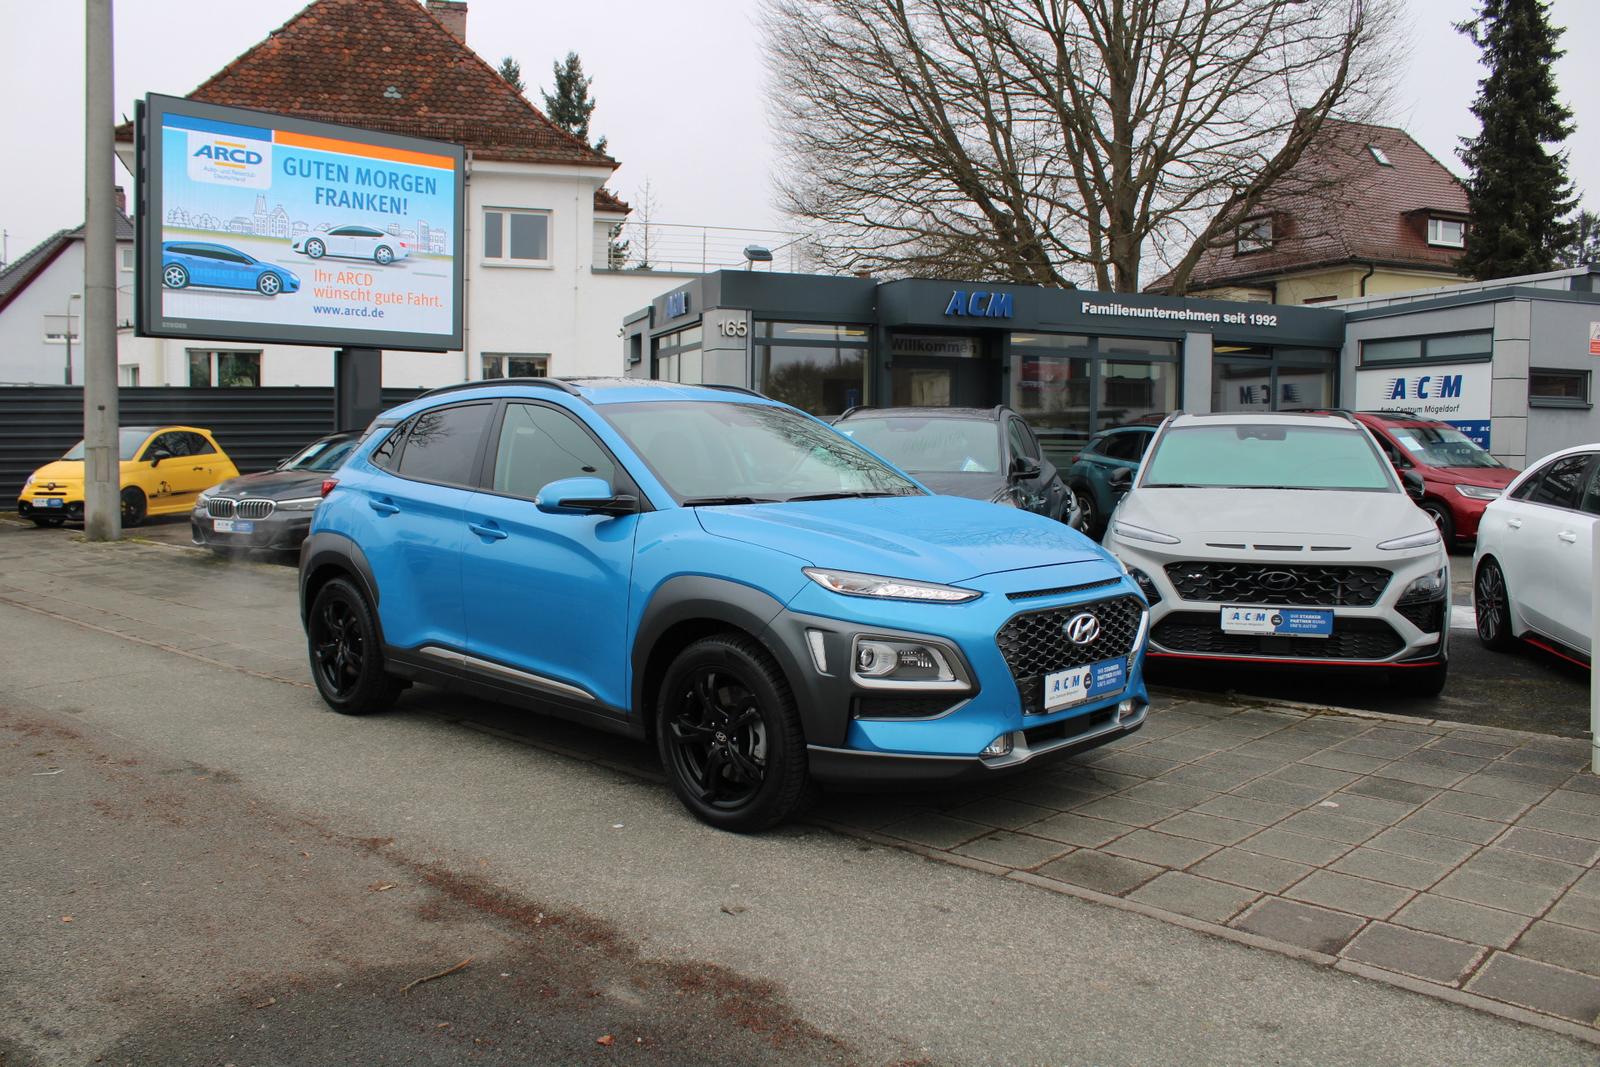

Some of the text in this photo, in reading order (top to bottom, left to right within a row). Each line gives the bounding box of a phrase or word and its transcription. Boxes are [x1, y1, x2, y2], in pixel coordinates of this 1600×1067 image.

[192, 144, 263, 165] ARCD
[283, 156, 437, 195] GUTEN MORGEN
[315, 186, 408, 216] FRANKEN!
[314, 269, 374, 287] Ihr ARCD
[313, 285, 443, 308] wünscht gute Fahrt.
[944, 289, 1014, 318] ACM
[313, 304, 385, 318] www.arcd.de
[1081, 301, 1278, 327] Familienunternehmen seit 1992
[718, 319, 748, 337] 165
[891, 337, 978, 354] Willkommen
